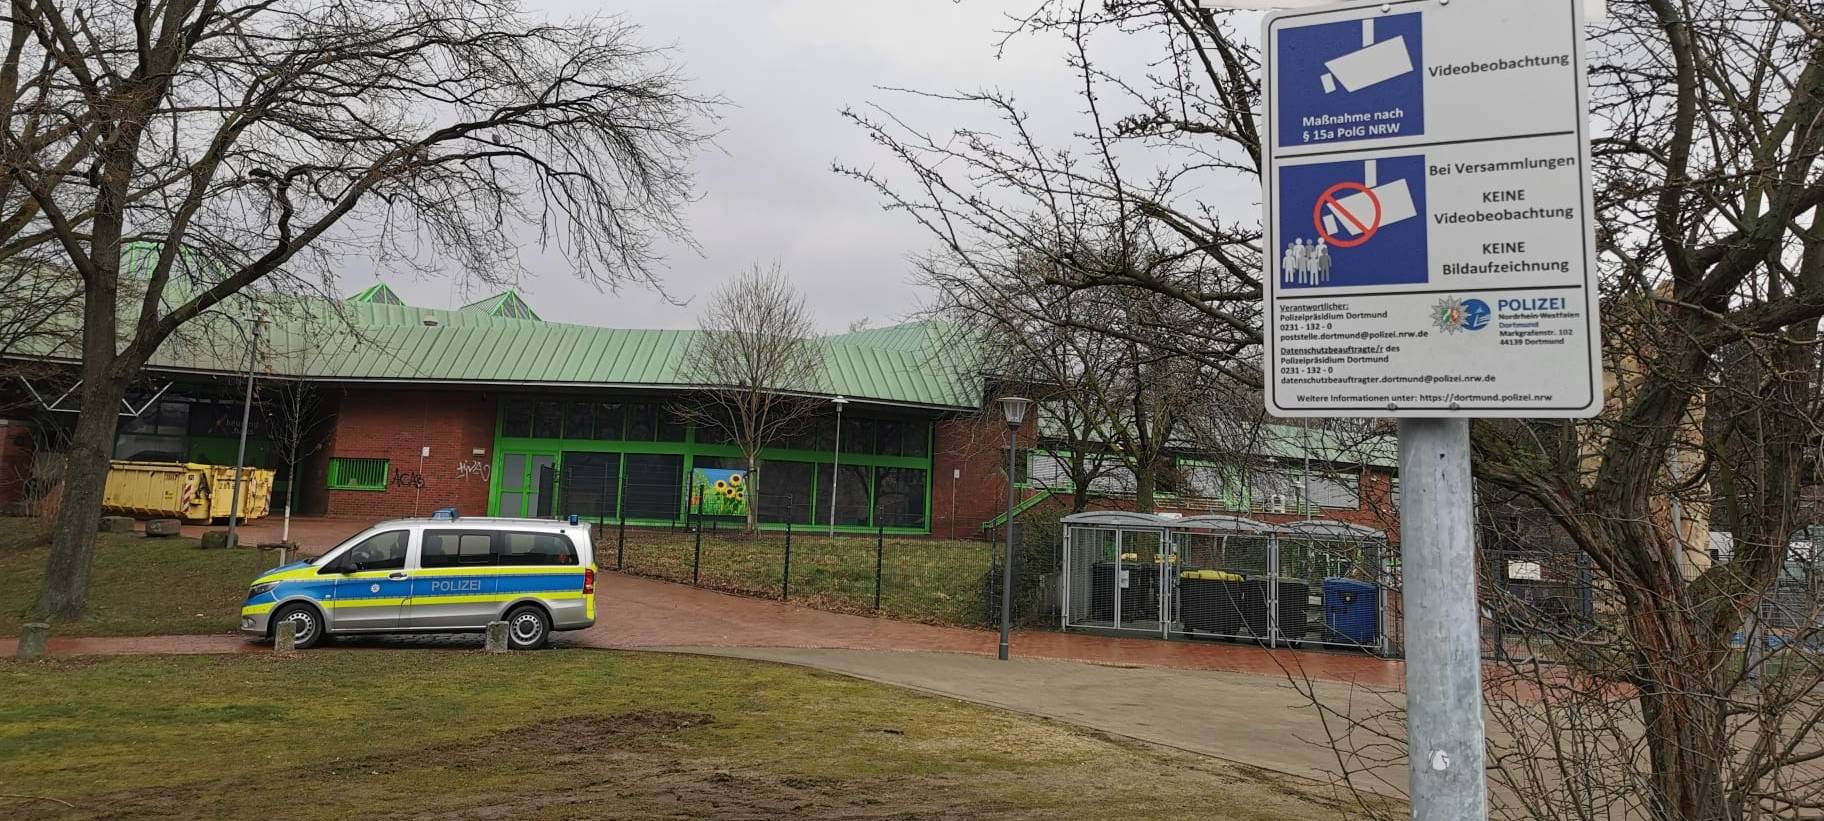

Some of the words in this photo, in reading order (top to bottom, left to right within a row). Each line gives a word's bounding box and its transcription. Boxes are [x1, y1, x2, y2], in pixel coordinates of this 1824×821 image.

[1428, 54, 1569, 77] Videobeobachtung
[1302, 113, 1371, 127] Maßnahme
[1374, 107, 1404, 120] nach
[1302, 131, 1310, 142] §
[1313, 129, 1334, 141] 15a
[1337, 126, 1365, 138] PolG
[1369, 123, 1401, 135] NRW
[1429, 163, 1451, 176] Bei
[1455, 156, 1576, 174] Versammlungen
[1482, 189, 1526, 203] KEINE
[1434, 207, 1574, 225] Videobeobachtung
[1482, 241, 1526, 255] KEINE
[1442, 260, 1569, 275] Bildaufzeichnung
[1280, 303, 1349, 313] Verantwortlicher:
[1498, 297, 1566, 311] POLIZEI
[1280, 312, 1344, 322] Polizeipräsidium
[1346, 310, 1388, 320] Dortmund
[1498, 311, 1580, 319] Nordrhein-Westfalen
[1280, 323, 1299, 331] 0231
[1306, 323, 1321, 331] 132
[1327, 322, 1333, 330] 0
[1280, 330, 1429, 342] poststelle.dortmund@polizei.nrw.de
[1525, 338, 1564, 346] Dortmund
[1280, 345, 1385, 355] Datenschutzbeauftragte/r
[1385, 345, 1401, 353] des
[1280, 357, 1345, 365] Polizeipräsidium
[1347, 355, 1389, 364] Dortmund
[1280, 367, 1299, 375] 0231
[1328, 366, 1333, 374] 0
[1281, 374, 1496, 385] datenschutzbeauftragter.dortmund@polizei.nrw.de
[1297, 394, 1329, 402] Weitere
[1330, 394, 1393, 402] Informationen
[1391, 394, 1418, 402] unter:
[1419, 393, 1553, 403] https://dortmund.polizei.nrw
[431, 580, 481, 592] POLIZEI
